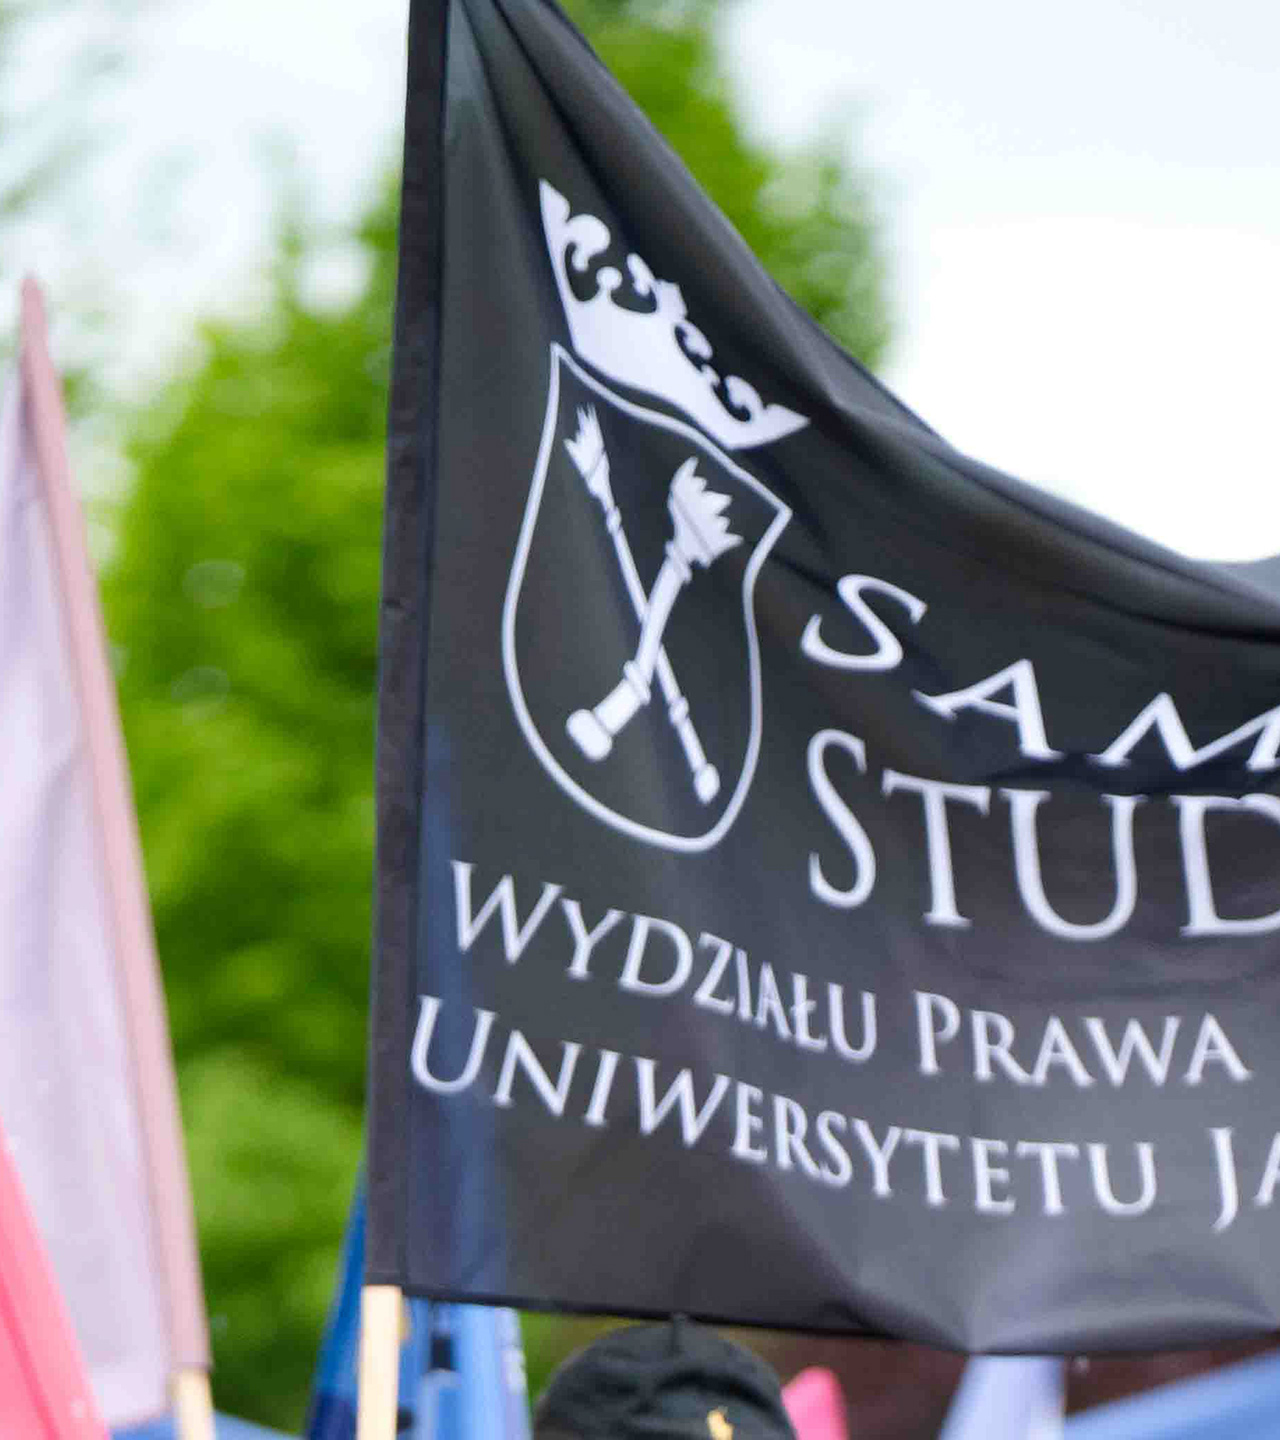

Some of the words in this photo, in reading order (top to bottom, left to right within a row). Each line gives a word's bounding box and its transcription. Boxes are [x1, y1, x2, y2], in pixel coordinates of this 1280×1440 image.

[451, 858, 879, 1064] WYDZIAŁU
[913, 988, 1254, 1090] PRAWA
[410, 994, 1159, 1218] UNIWERSYTETU
